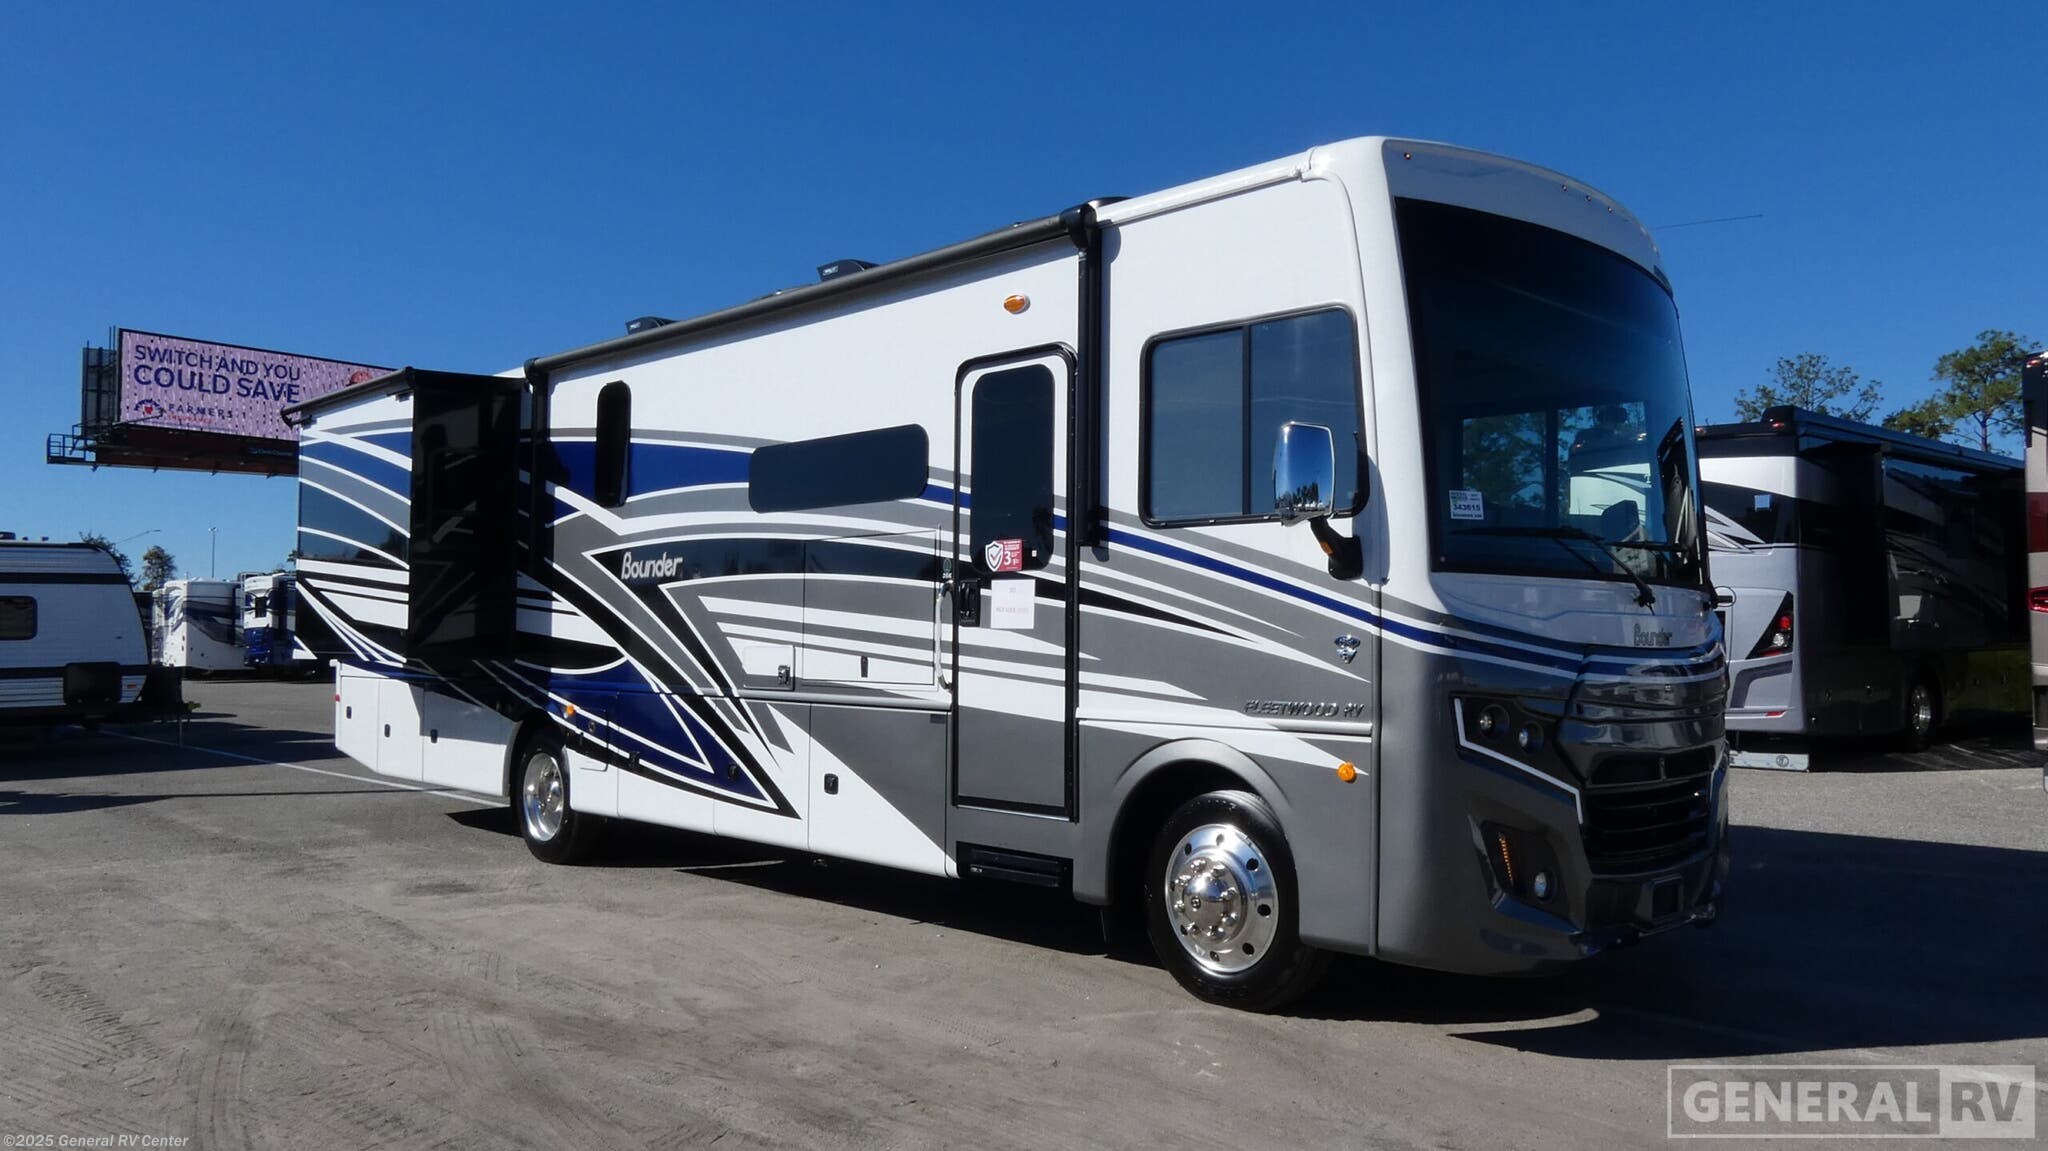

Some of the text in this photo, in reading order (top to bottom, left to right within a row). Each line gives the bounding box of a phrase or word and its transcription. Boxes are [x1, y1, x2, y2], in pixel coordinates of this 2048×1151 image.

[135, 345, 300, 381] SWITCH AND YOU
[134, 365, 300, 403] COULD SAVE
[168, 404, 233, 419] FARMERS
[621, 552, 683, 580] Bounder
[1003, 551, 1011, 566] 3
[1634, 623, 1672, 647] Bounder
[1244, 700, 1365, 718] FLEETWOOD RV
